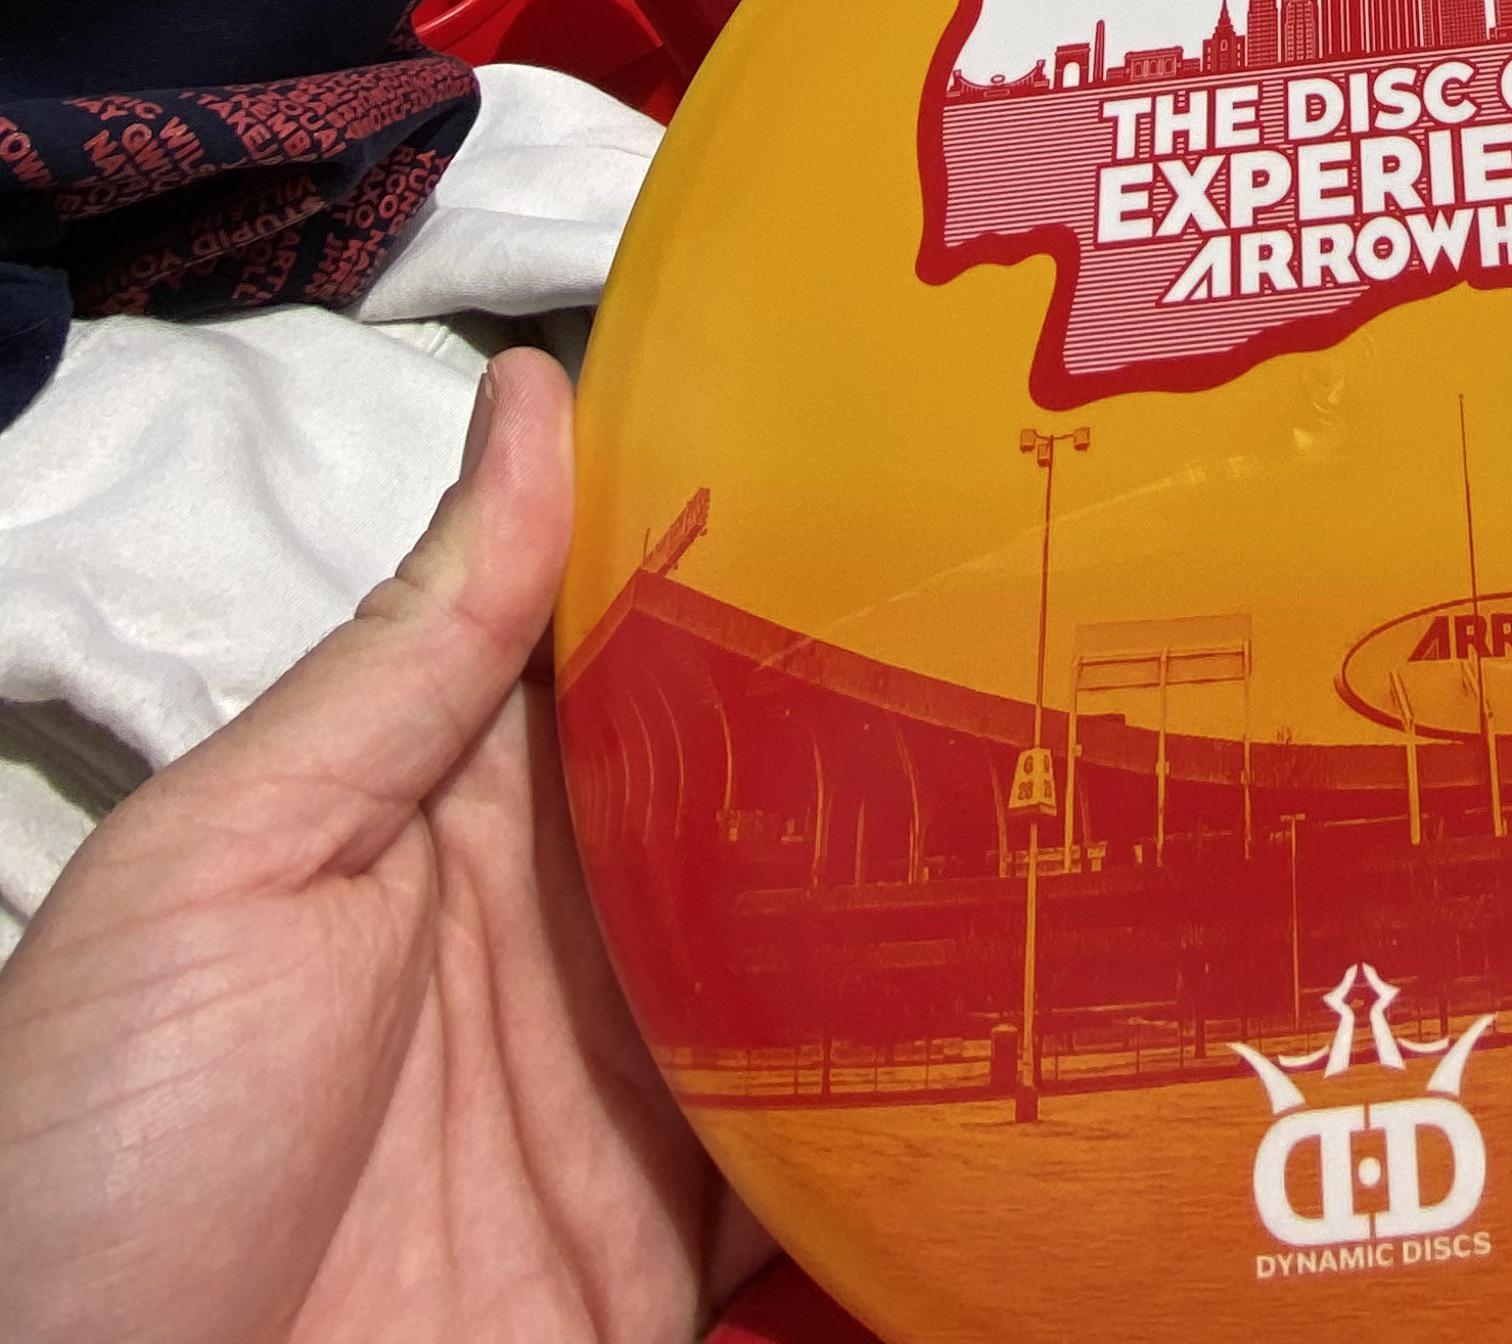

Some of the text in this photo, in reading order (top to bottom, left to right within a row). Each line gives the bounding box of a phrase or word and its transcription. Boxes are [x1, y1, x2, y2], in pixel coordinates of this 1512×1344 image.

[1102, 86, 1262, 160] THE
[1285, 62, 1481, 137] DISC
[1255, 1232, 1492, 1278] DYNAMIC DISCS
